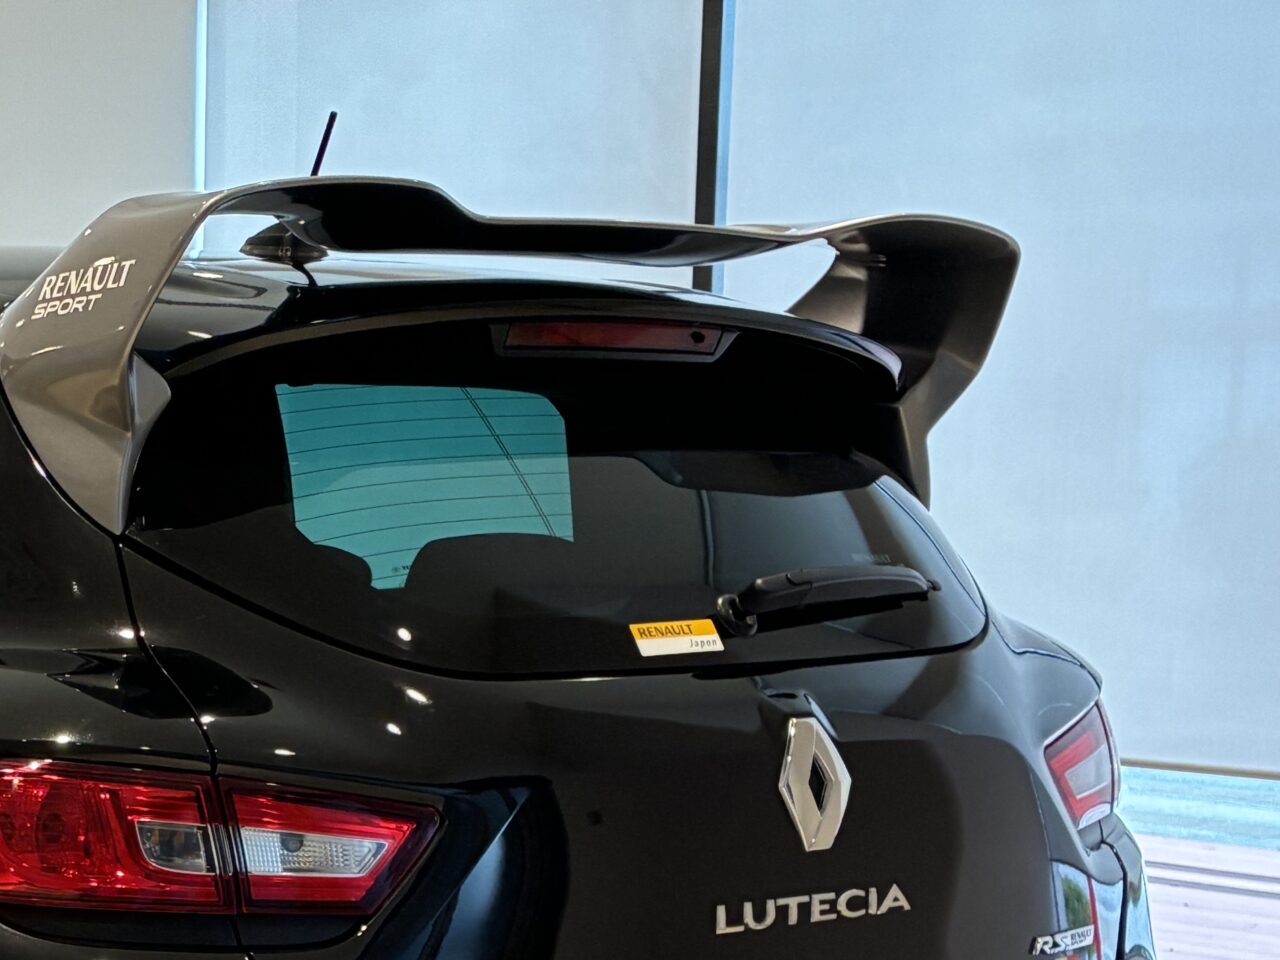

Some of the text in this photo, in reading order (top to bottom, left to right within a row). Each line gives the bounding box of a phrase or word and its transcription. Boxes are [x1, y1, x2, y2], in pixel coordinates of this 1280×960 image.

[38, 259, 136, 301] RENAULT
[31, 294, 103, 320] SPORT
[637, 624, 694, 639] RENAULT
[689, 639, 718, 649] Japon
[716, 883, 912, 935] LUTECIA
